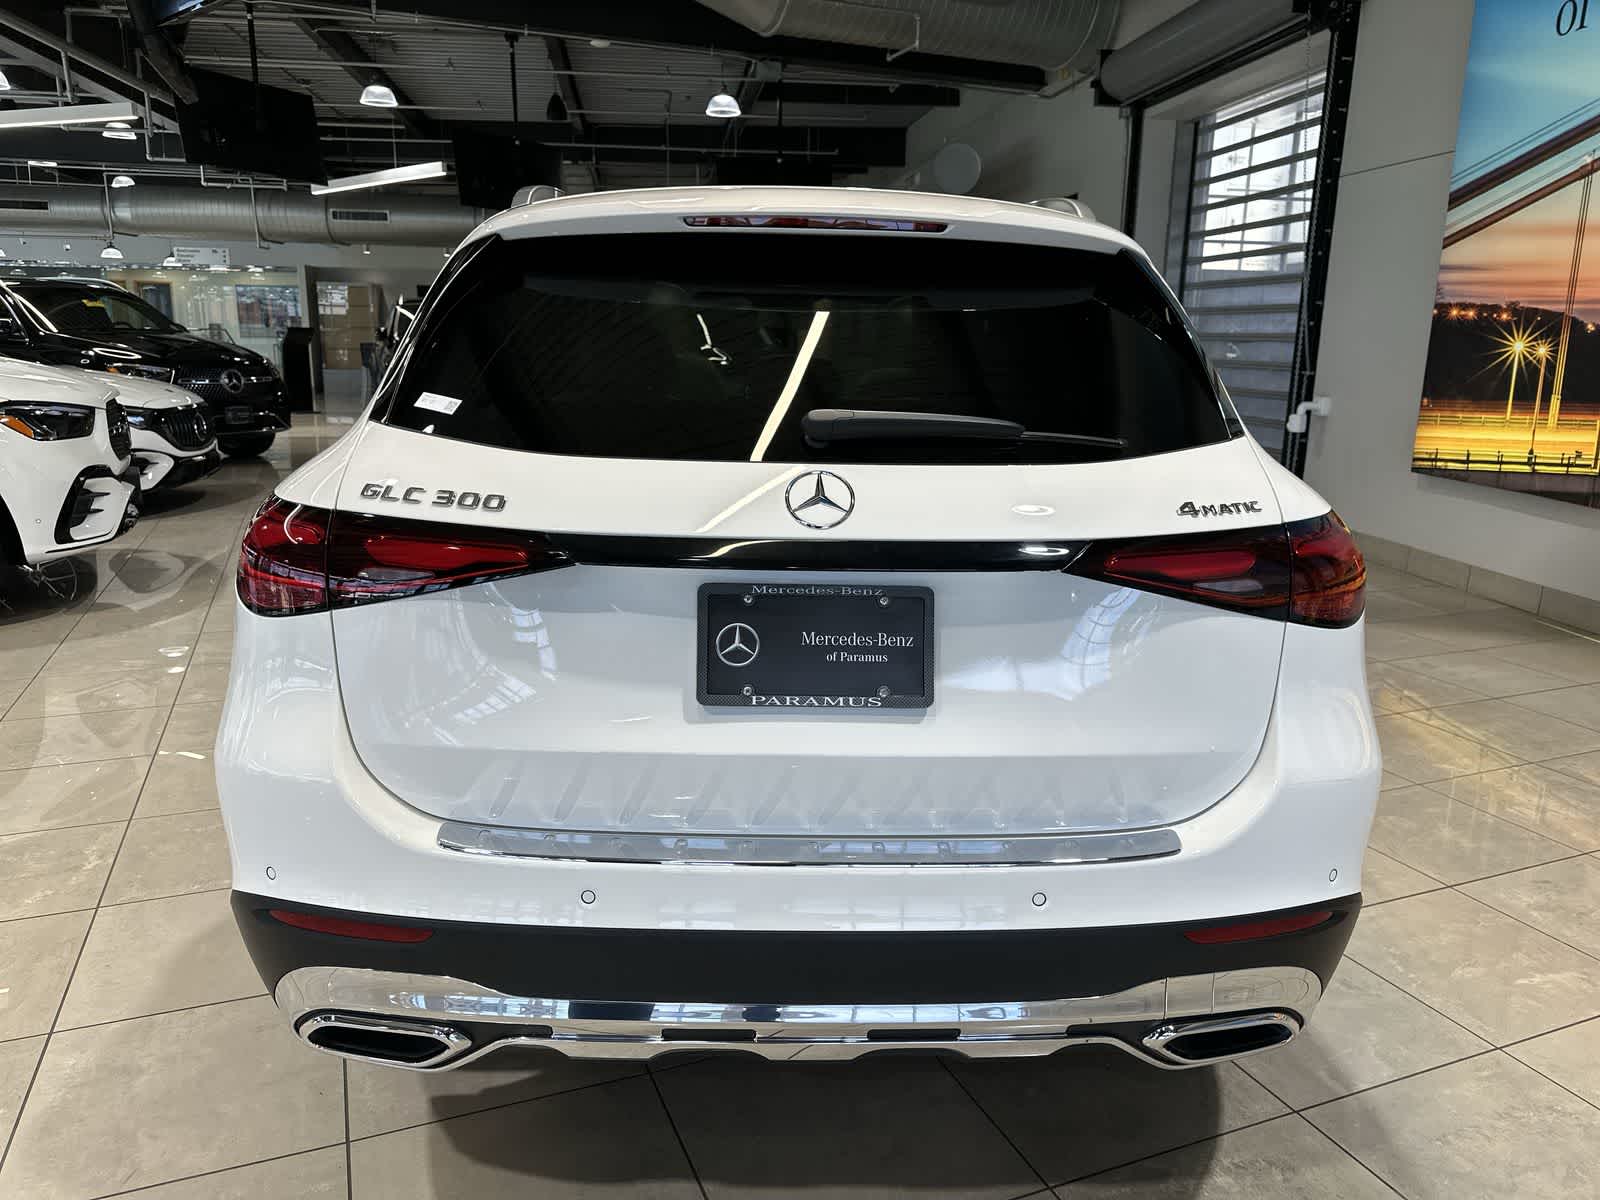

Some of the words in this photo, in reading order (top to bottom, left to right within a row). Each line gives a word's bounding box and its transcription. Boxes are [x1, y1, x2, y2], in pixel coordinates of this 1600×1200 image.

[360, 482, 426, 504] GLC
[431, 489, 507, 513] 300
[1176, 500, 1262, 518] 4MATIC
[751, 585, 884, 597] Mercedes-Benz
[800, 631, 914, 648] Mercedes-Benz
[826, 651, 837, 663] of
[839, 651, 889, 664] Paramus
[751, 695, 883, 708] PARAMUS
